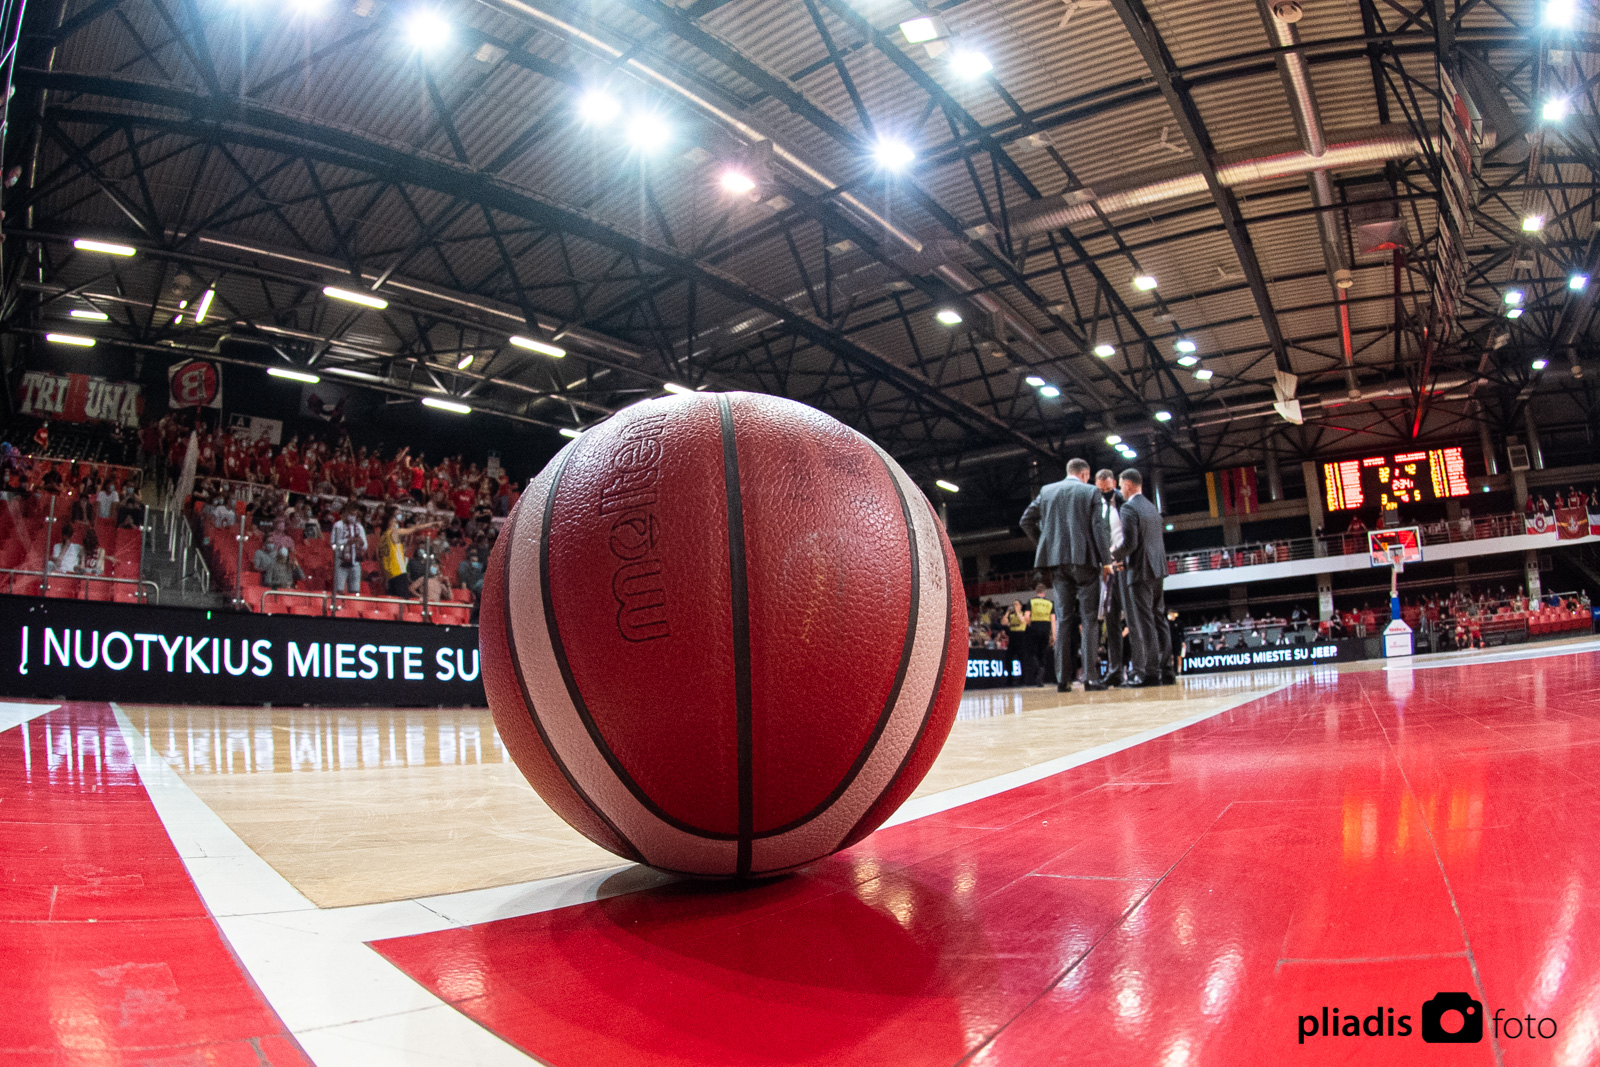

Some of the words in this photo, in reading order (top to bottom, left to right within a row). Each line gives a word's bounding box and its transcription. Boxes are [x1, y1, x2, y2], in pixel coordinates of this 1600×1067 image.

[20, 372, 140, 428] TRIUNA
[600, 413, 670, 643] molten
[19, 625, 29, 675] Į
[43, 627, 273, 677] NUOTYKIUS
[287, 641, 424, 680] MIESTE
[435, 647, 480, 681] SU
[966, 659, 990, 678] ESTE
[1188, 652, 1251, 669] NUOTYKIUS
[1253, 648, 1292, 664] MIESTE
[1293, 647, 1309, 661] SU
